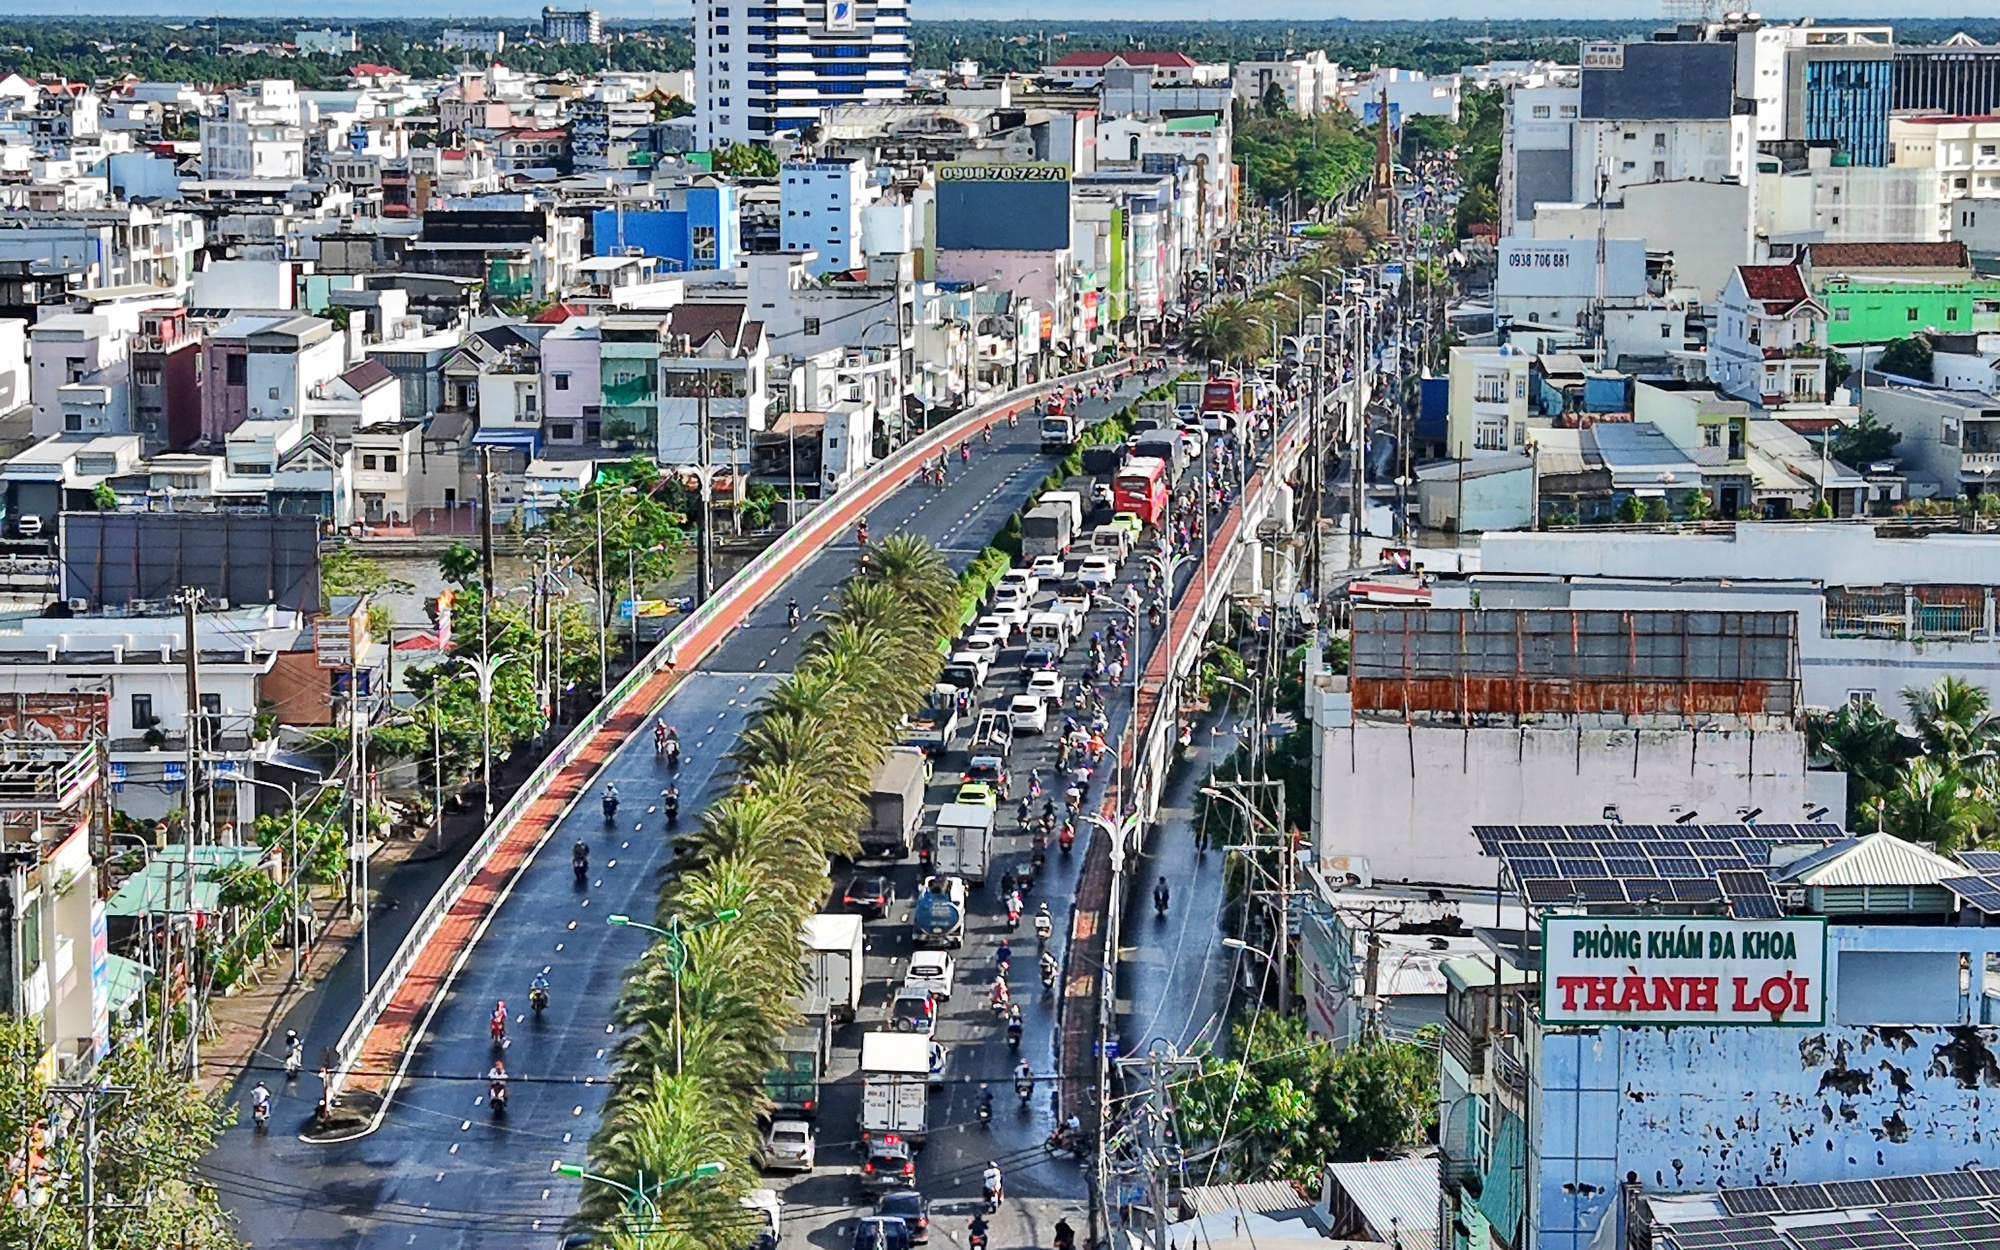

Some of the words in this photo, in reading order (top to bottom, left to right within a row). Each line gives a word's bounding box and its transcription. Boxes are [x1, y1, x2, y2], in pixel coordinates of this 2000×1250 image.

[1509, 253, 1531, 267] 0938
[1534, 253, 1551, 267] 706
[1553, 253, 1570, 267] 881
[1573, 923, 1641, 958] PHÒNG
[1648, 924, 1703, 959] KHÁM
[1709, 931, 1736, 959] ĐA
[1742, 931, 1797, 960] KHOA
[1556, 965, 1719, 1012] THÀNH
[1732, 970, 1809, 1021] LỢI
